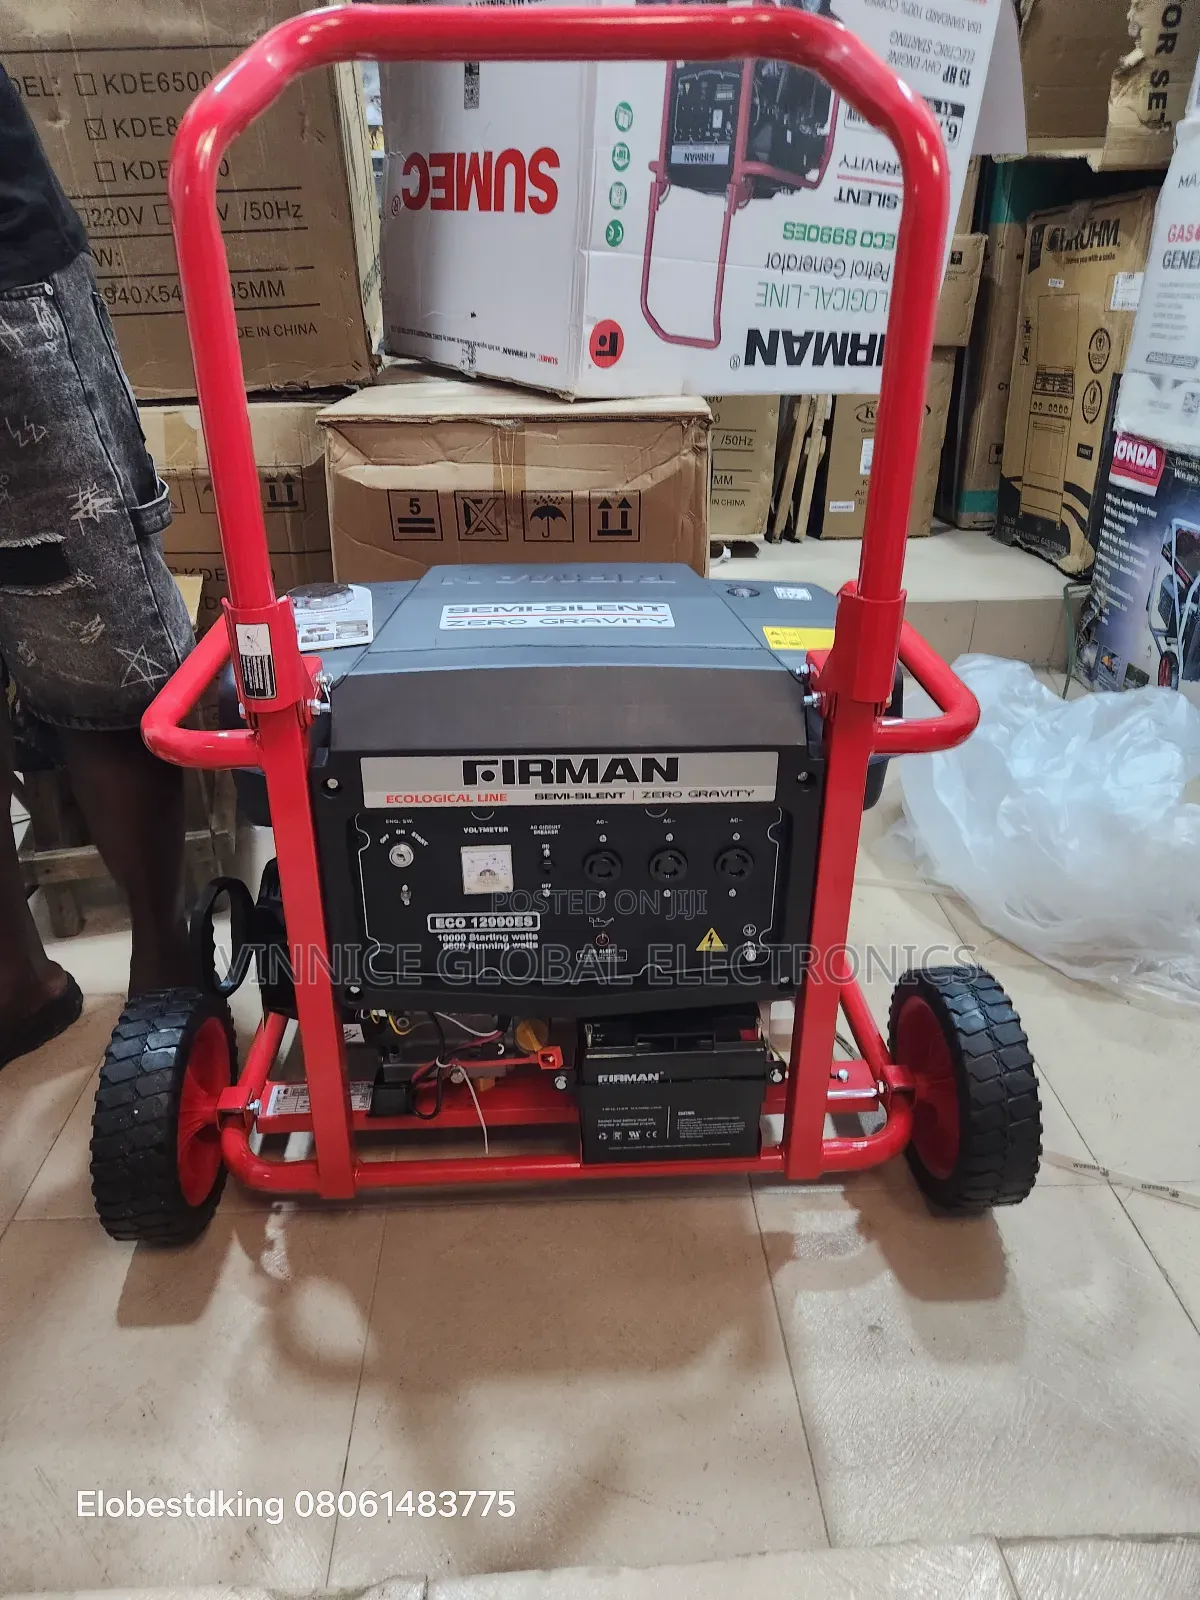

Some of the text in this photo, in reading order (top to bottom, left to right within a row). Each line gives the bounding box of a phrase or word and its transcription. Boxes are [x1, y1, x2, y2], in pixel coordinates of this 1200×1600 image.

[889, 29, 976, 64] ELECTRIC STARTING
[942, 63, 957, 86] HP
[960, 67, 972, 88] 15
[401, 146, 561, 215] SUMEC
[244, 201, 304, 221] /50Hz
[783, 221, 896, 251] ECO 8990ES
[764, 251, 890, 282] Petrol Generator
[257, 325, 270, 337] IN
[273, 323, 318, 337] CHINA
[721, 435, 754, 446] /50Hz
[447, 604, 666, 614] SEMI-SILENT
[447, 617, 669, 627] ZERO GRAVITY
[462, 757, 679, 787] FIRMAN
[386, 789, 755, 804] ECOLOGICAL LINE SEMI-SILENT ZERO GRAVITY
[463, 826, 509, 834] VOLTMETER
[435, 917, 466, 929] ECO
[469, 933, 509, 942] Starting
[511, 933, 539, 941] watts
[468, 942, 509, 951] Running
[512, 942, 539, 950] watts
[598, 1072, 660, 1083] FIRMAN
